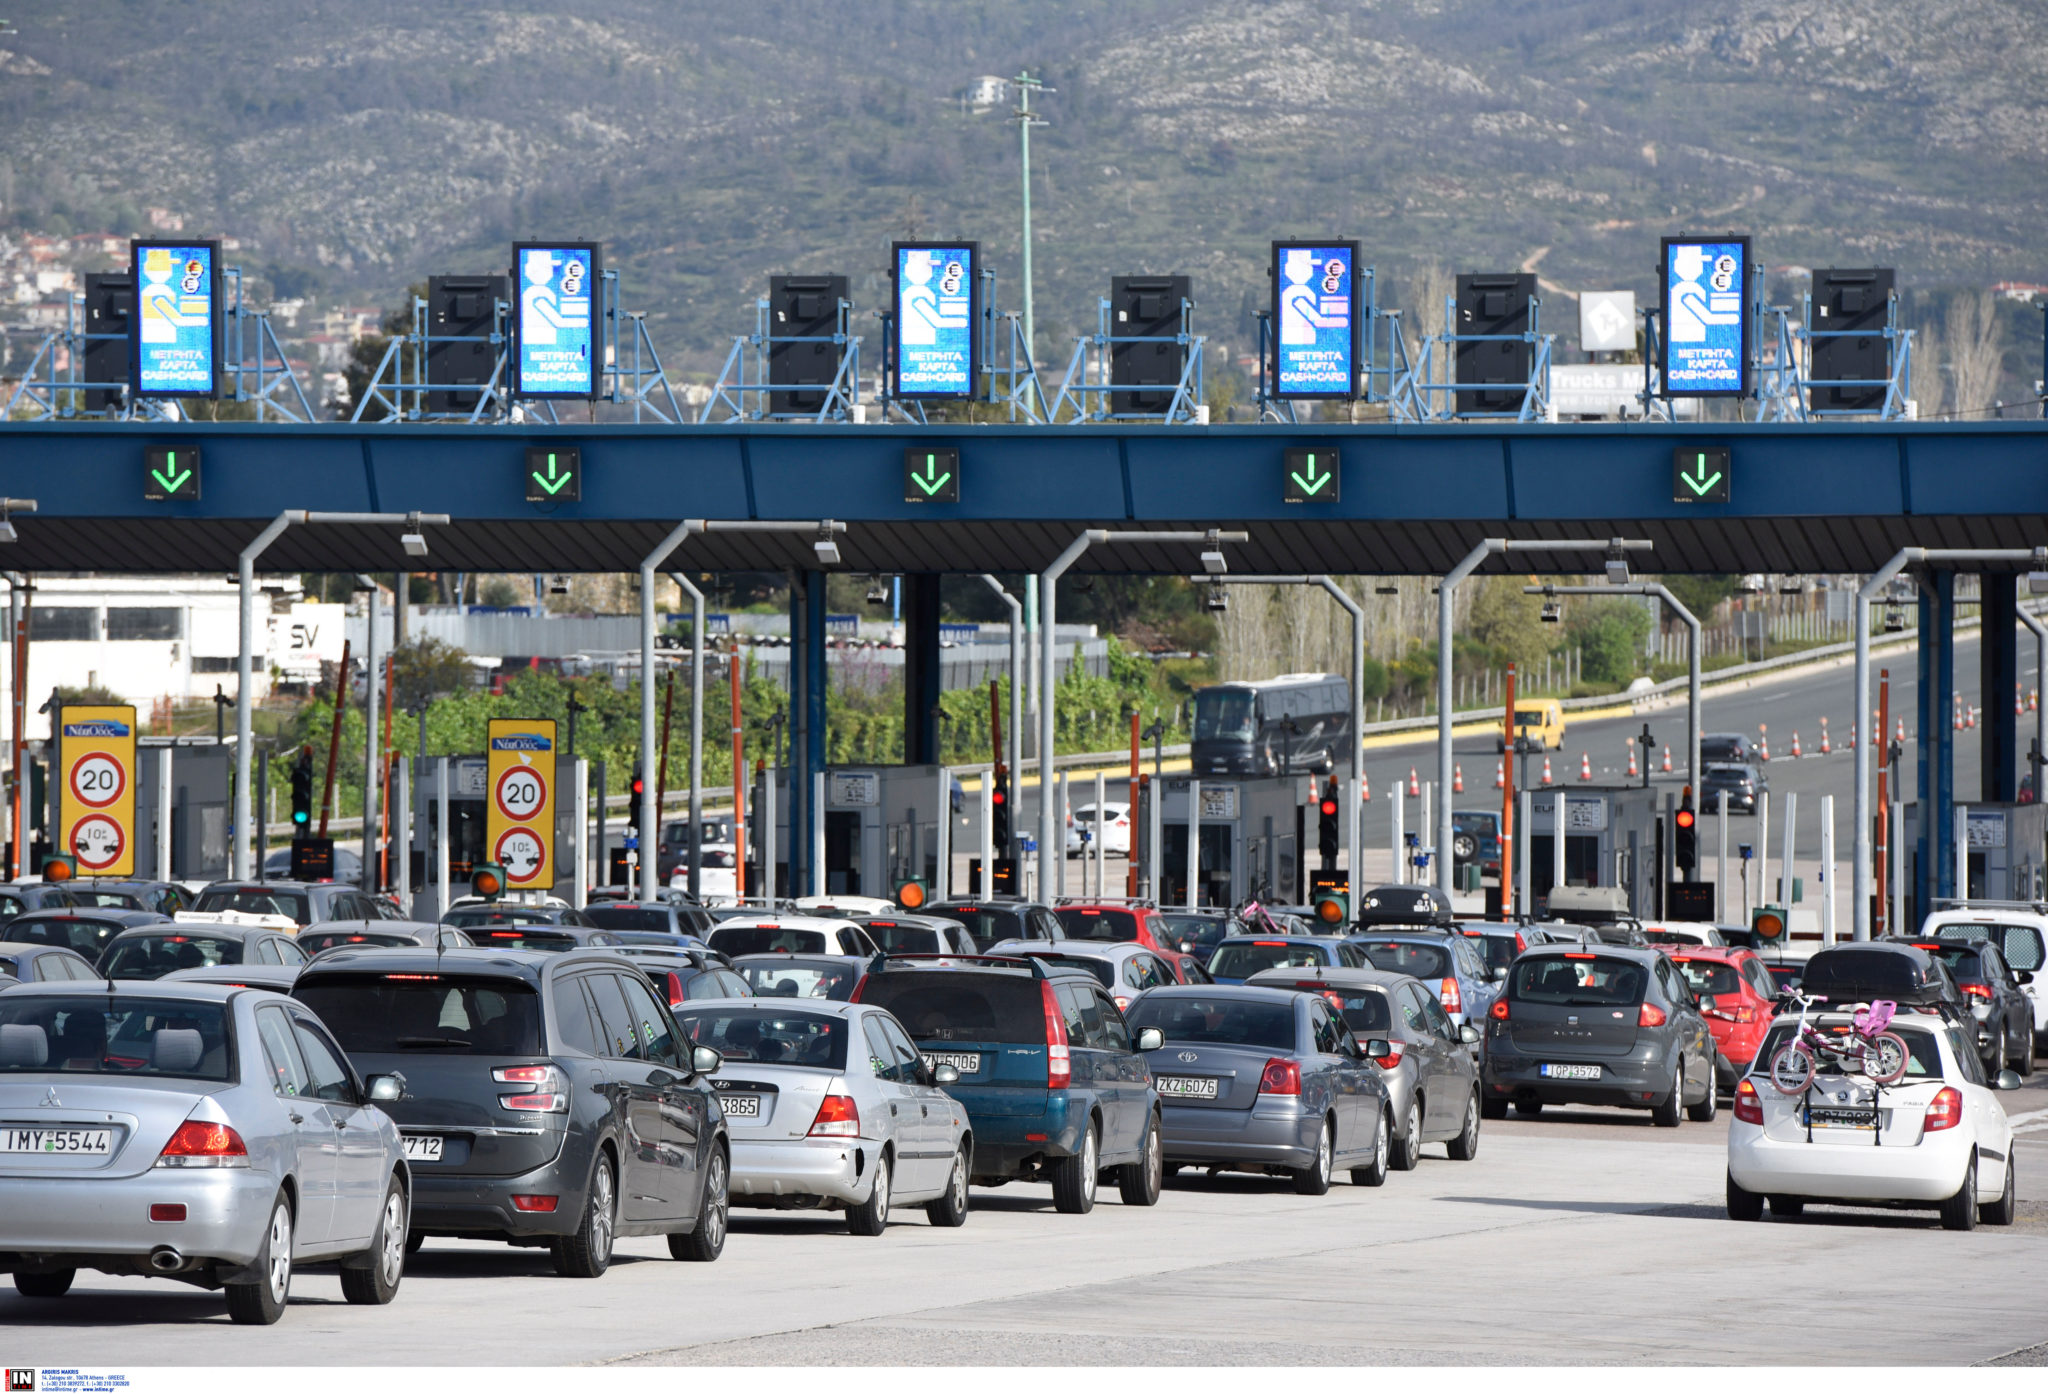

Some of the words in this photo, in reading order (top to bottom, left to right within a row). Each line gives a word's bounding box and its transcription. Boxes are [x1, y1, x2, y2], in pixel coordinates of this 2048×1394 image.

[919, 362, 957, 371] ΚΑΡΤΑ
[1299, 362, 1337, 371] ΚΑΡΤΑ
[1688, 359, 1728, 369] ΚΑΡΤΑ
[1551, 371, 1618, 388] Trucks
[291, 624, 319, 648] SV
[82, 769, 113, 790] 20
[507, 783, 535, 803] 20
